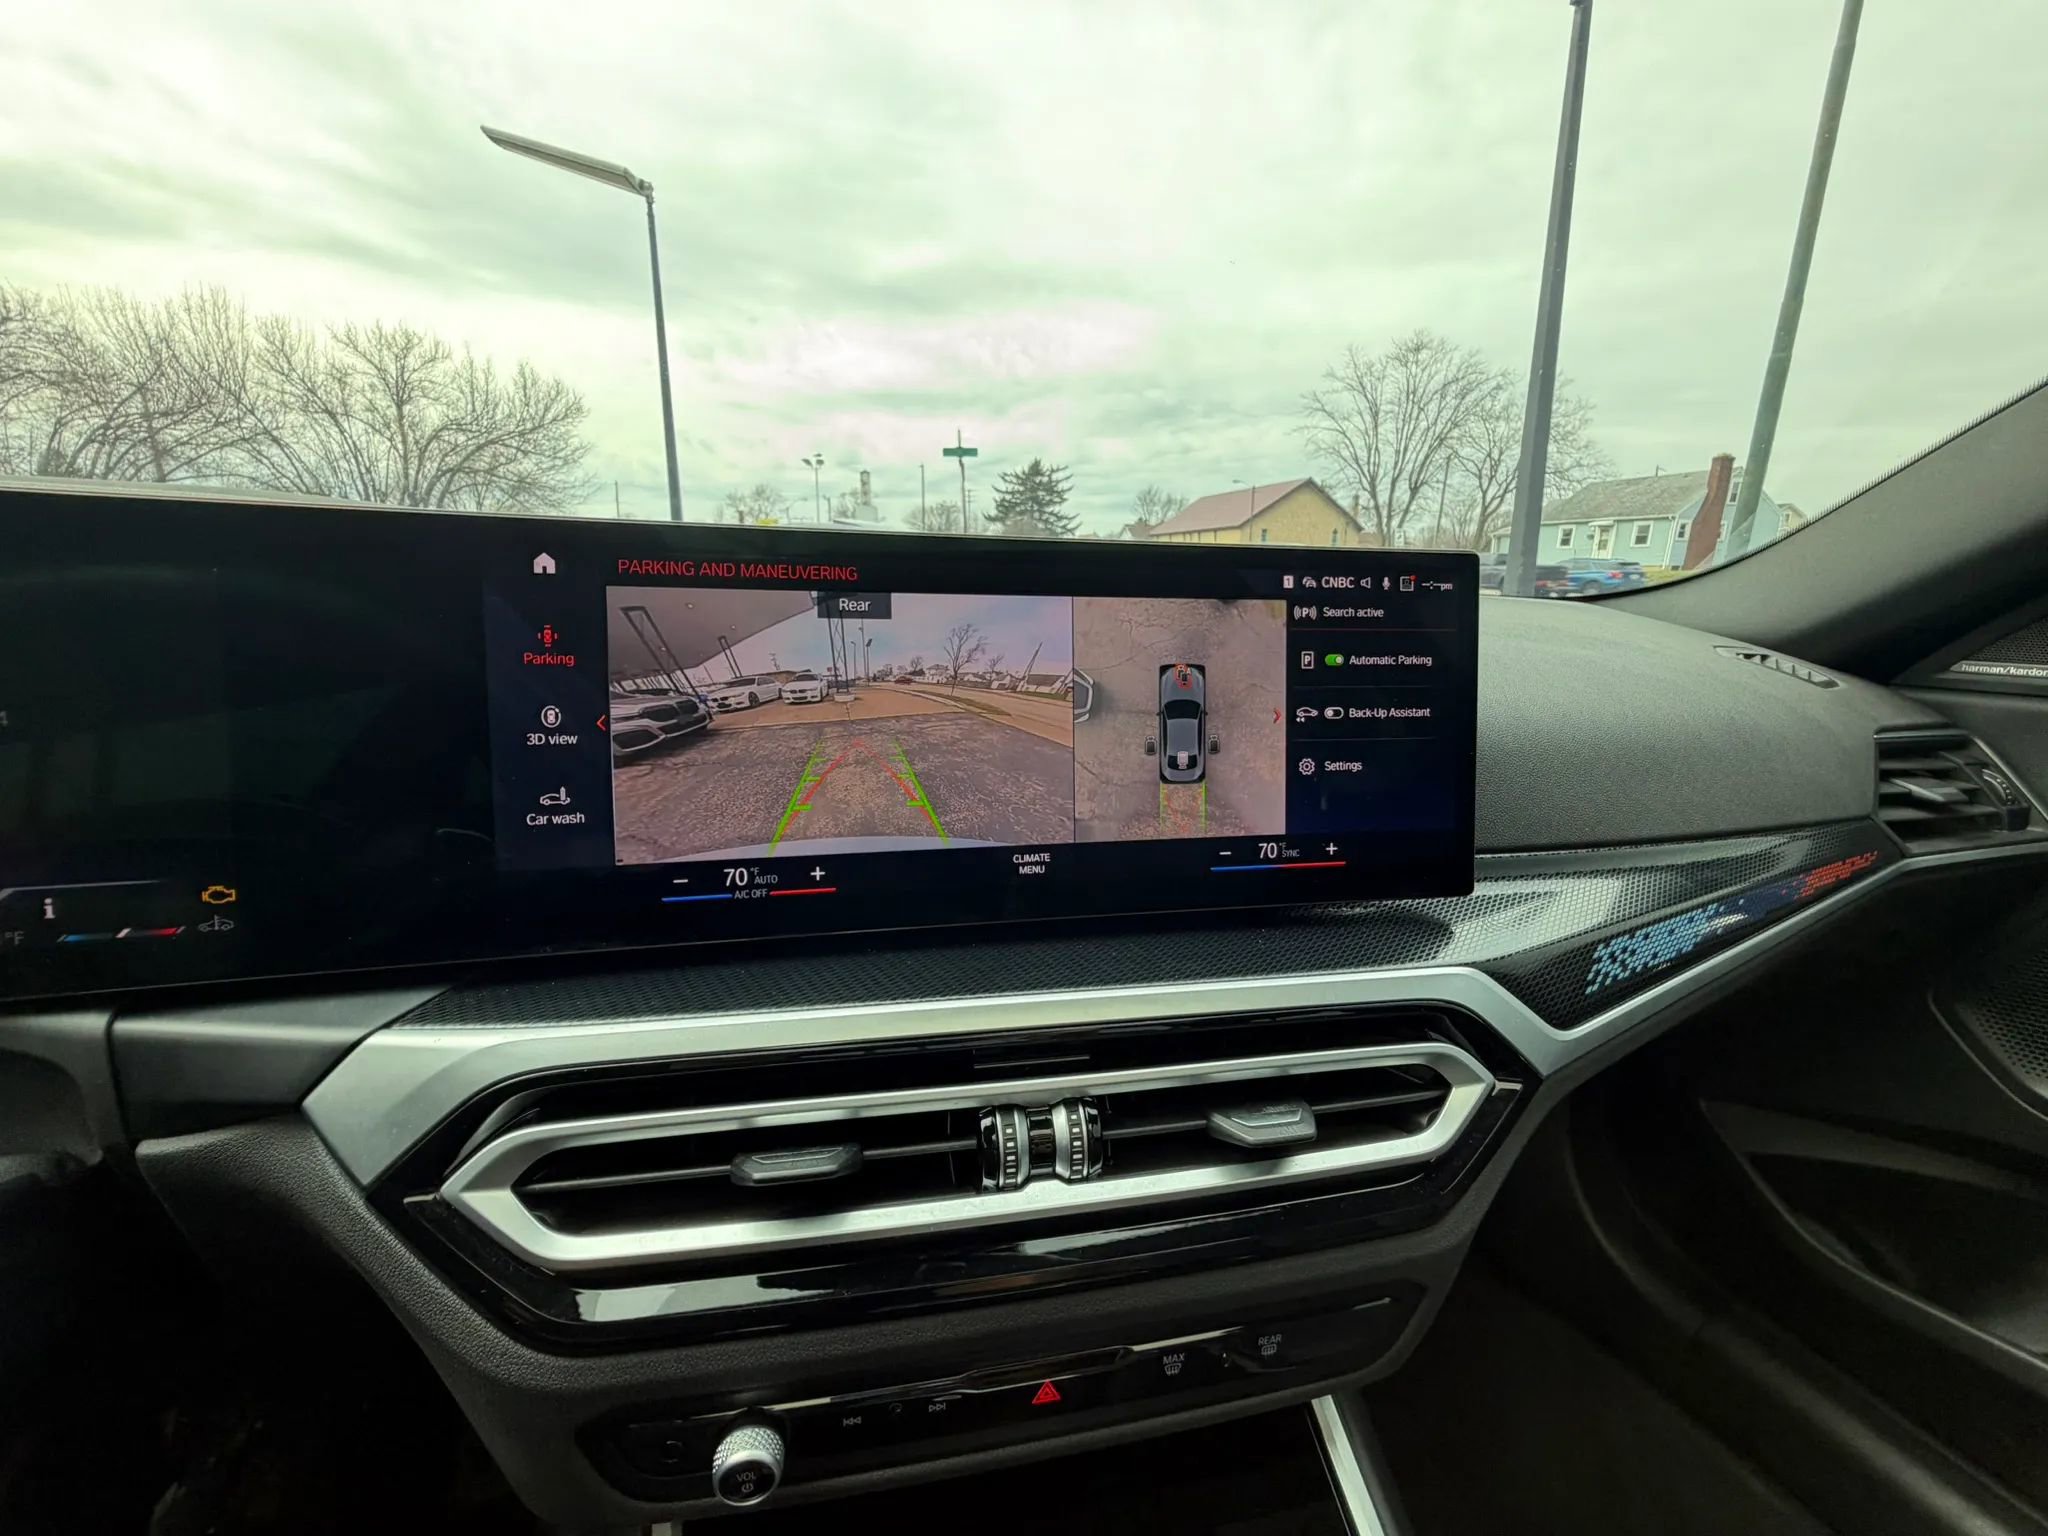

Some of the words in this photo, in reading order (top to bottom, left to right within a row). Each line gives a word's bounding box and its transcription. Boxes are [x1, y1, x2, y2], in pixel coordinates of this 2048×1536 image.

[618, 559, 695, 577] PARKING
[700, 561, 736, 578] AND
[740, 563, 858, 581] MANEUVERING
[1321, 576, 1355, 589] CNBC
[839, 598, 871, 612] Rear
[1323, 606, 1354, 618] Search
[1356, 607, 1384, 618] active
[523, 652, 575, 667] Parking
[1349, 655, 1396, 666] Automatic
[1398, 655, 1433, 667] Parking
[1349, 707, 1387, 720] Back-Up
[1389, 707, 1431, 718] Assistant
[526, 733, 546, 746] 3D
[548, 732, 578, 745] view
[1324, 761, 1363, 773] Settings
[526, 813, 549, 826] Car
[551, 812, 585, 825] wash
[1258, 842, 1278, 859] 70
[1281, 848, 1300, 858] SYNC
[1012, 852, 1051, 864] CLIMATE
[1018, 865, 1046, 875] MENU
[723, 867, 748, 887] 70
[754, 875, 779, 885] AUTO
[734, 890, 750, 899] A/C
[751, 888, 768, 898] OFF
[1258, 1334, 1282, 1346] REAR
[1163, 1352, 1185, 1365] MAX
[736, 1471, 757, 1482] VOL
